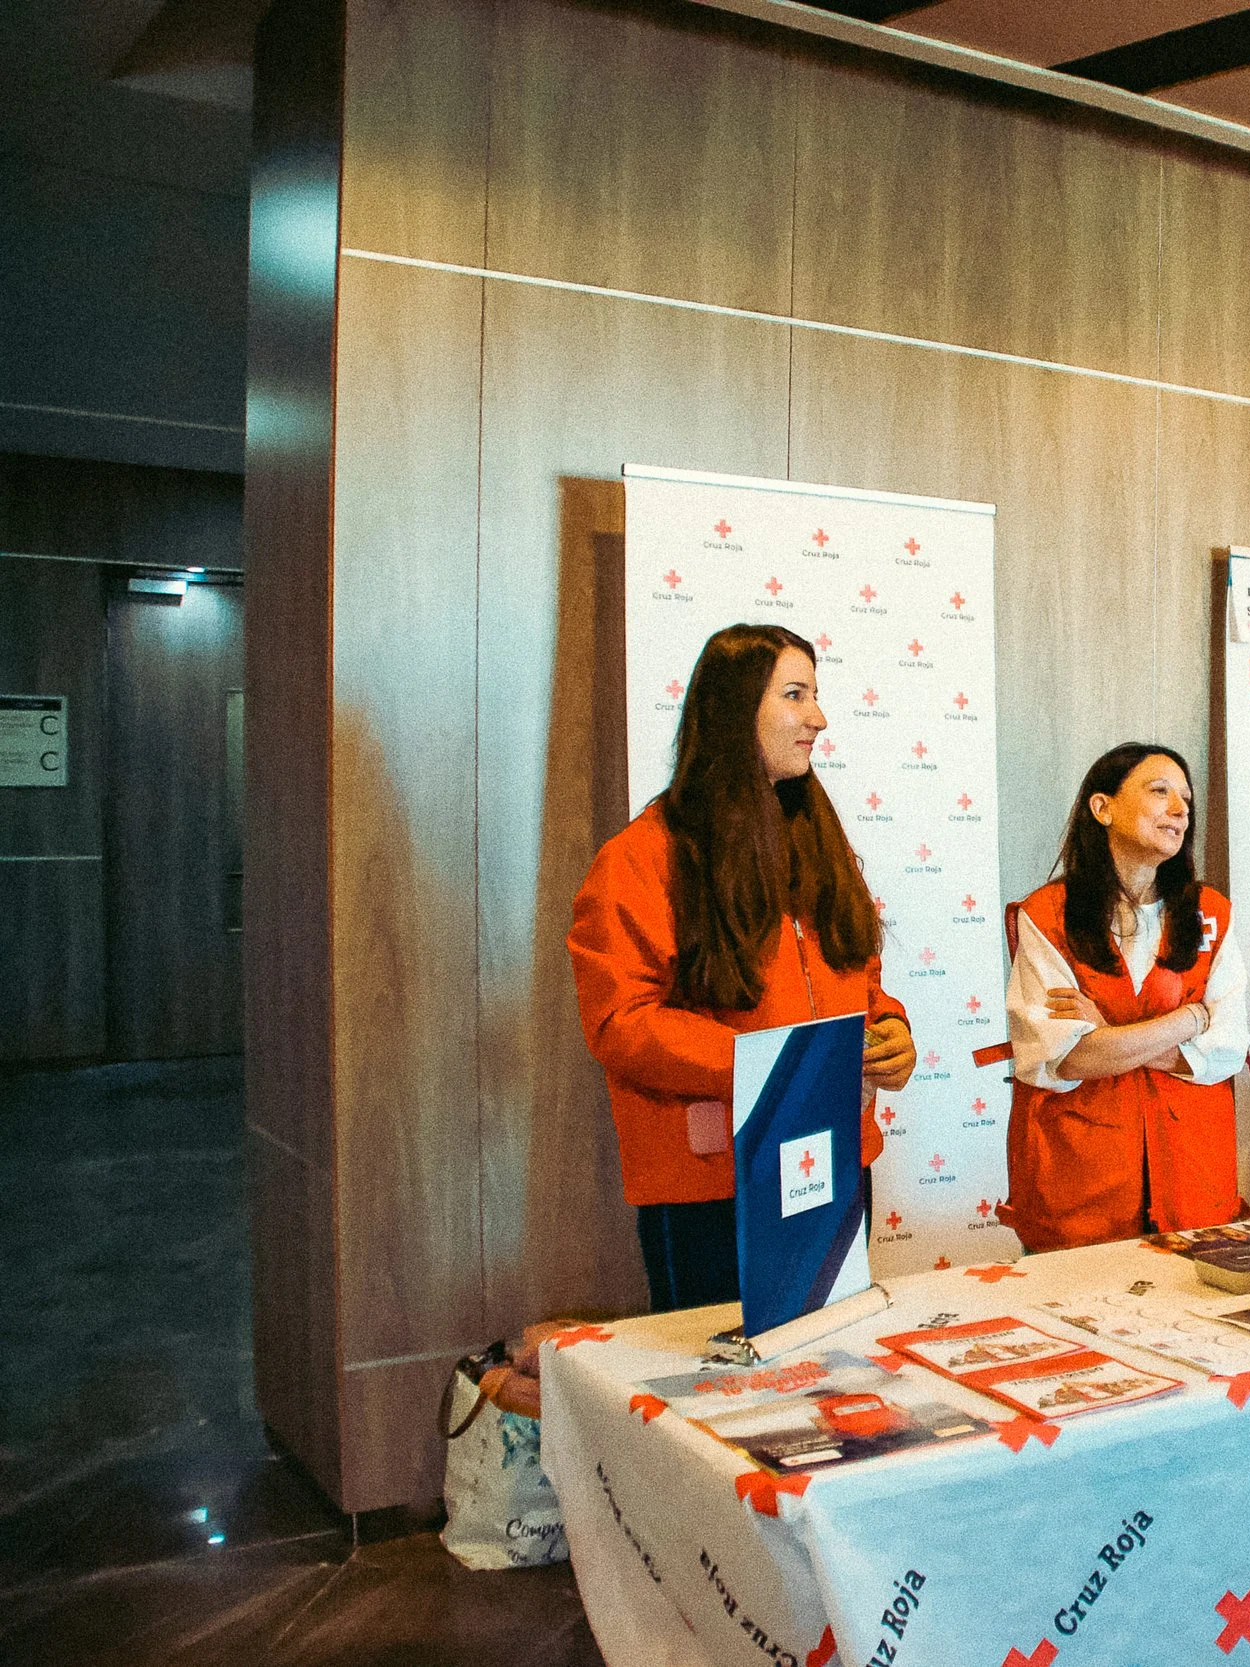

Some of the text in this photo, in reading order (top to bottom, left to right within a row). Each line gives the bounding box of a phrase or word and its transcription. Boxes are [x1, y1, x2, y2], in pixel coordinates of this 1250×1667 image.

[703, 540, 743, 552] Cruz Roja
[802, 549, 819, 557] Cruz
[895, 557, 931, 568] Cruz Roja
[652, 592, 694, 603] Cruz Roja
[755, 599, 794, 609] Cruz Roja
[850, 605, 887, 615] Cruz Roja
[941, 612, 975, 622] Cruz Roja
[824, 655, 843, 664] Roja
[899, 660, 934, 669] Cruz Roja
[655, 703, 675, 711] Cruz
[873, 710, 890, 719] Roja
[962, 714, 978, 722] Roja
[812, 761, 846, 770] ruz Roja
[920, 763, 937, 771] Roja
[875, 815, 893, 823] Roja
[965, 815, 981, 823] Roja
[924, 865, 942, 874] Roja
[881, 918, 897, 926] oja
[971, 915, 985, 924] Roja
[928, 969, 946, 978] Roja
[957, 1017, 990, 1026] Cruz Roja
[934, 1071, 951, 1081] Roja
[980, 1119, 996, 1127] Roja
[890, 1128, 907, 1137] Roja
[938, 1174, 956, 1183] Roja
[789, 1181, 825, 1199] Cruz Roja
[986, 1219, 999, 1228] Roj
[878, 1231, 912, 1243] Cruz Roja
[1054, 1509, 1155, 1637] Cruz Roja
[864, 1568, 928, 1667] uz Roja
